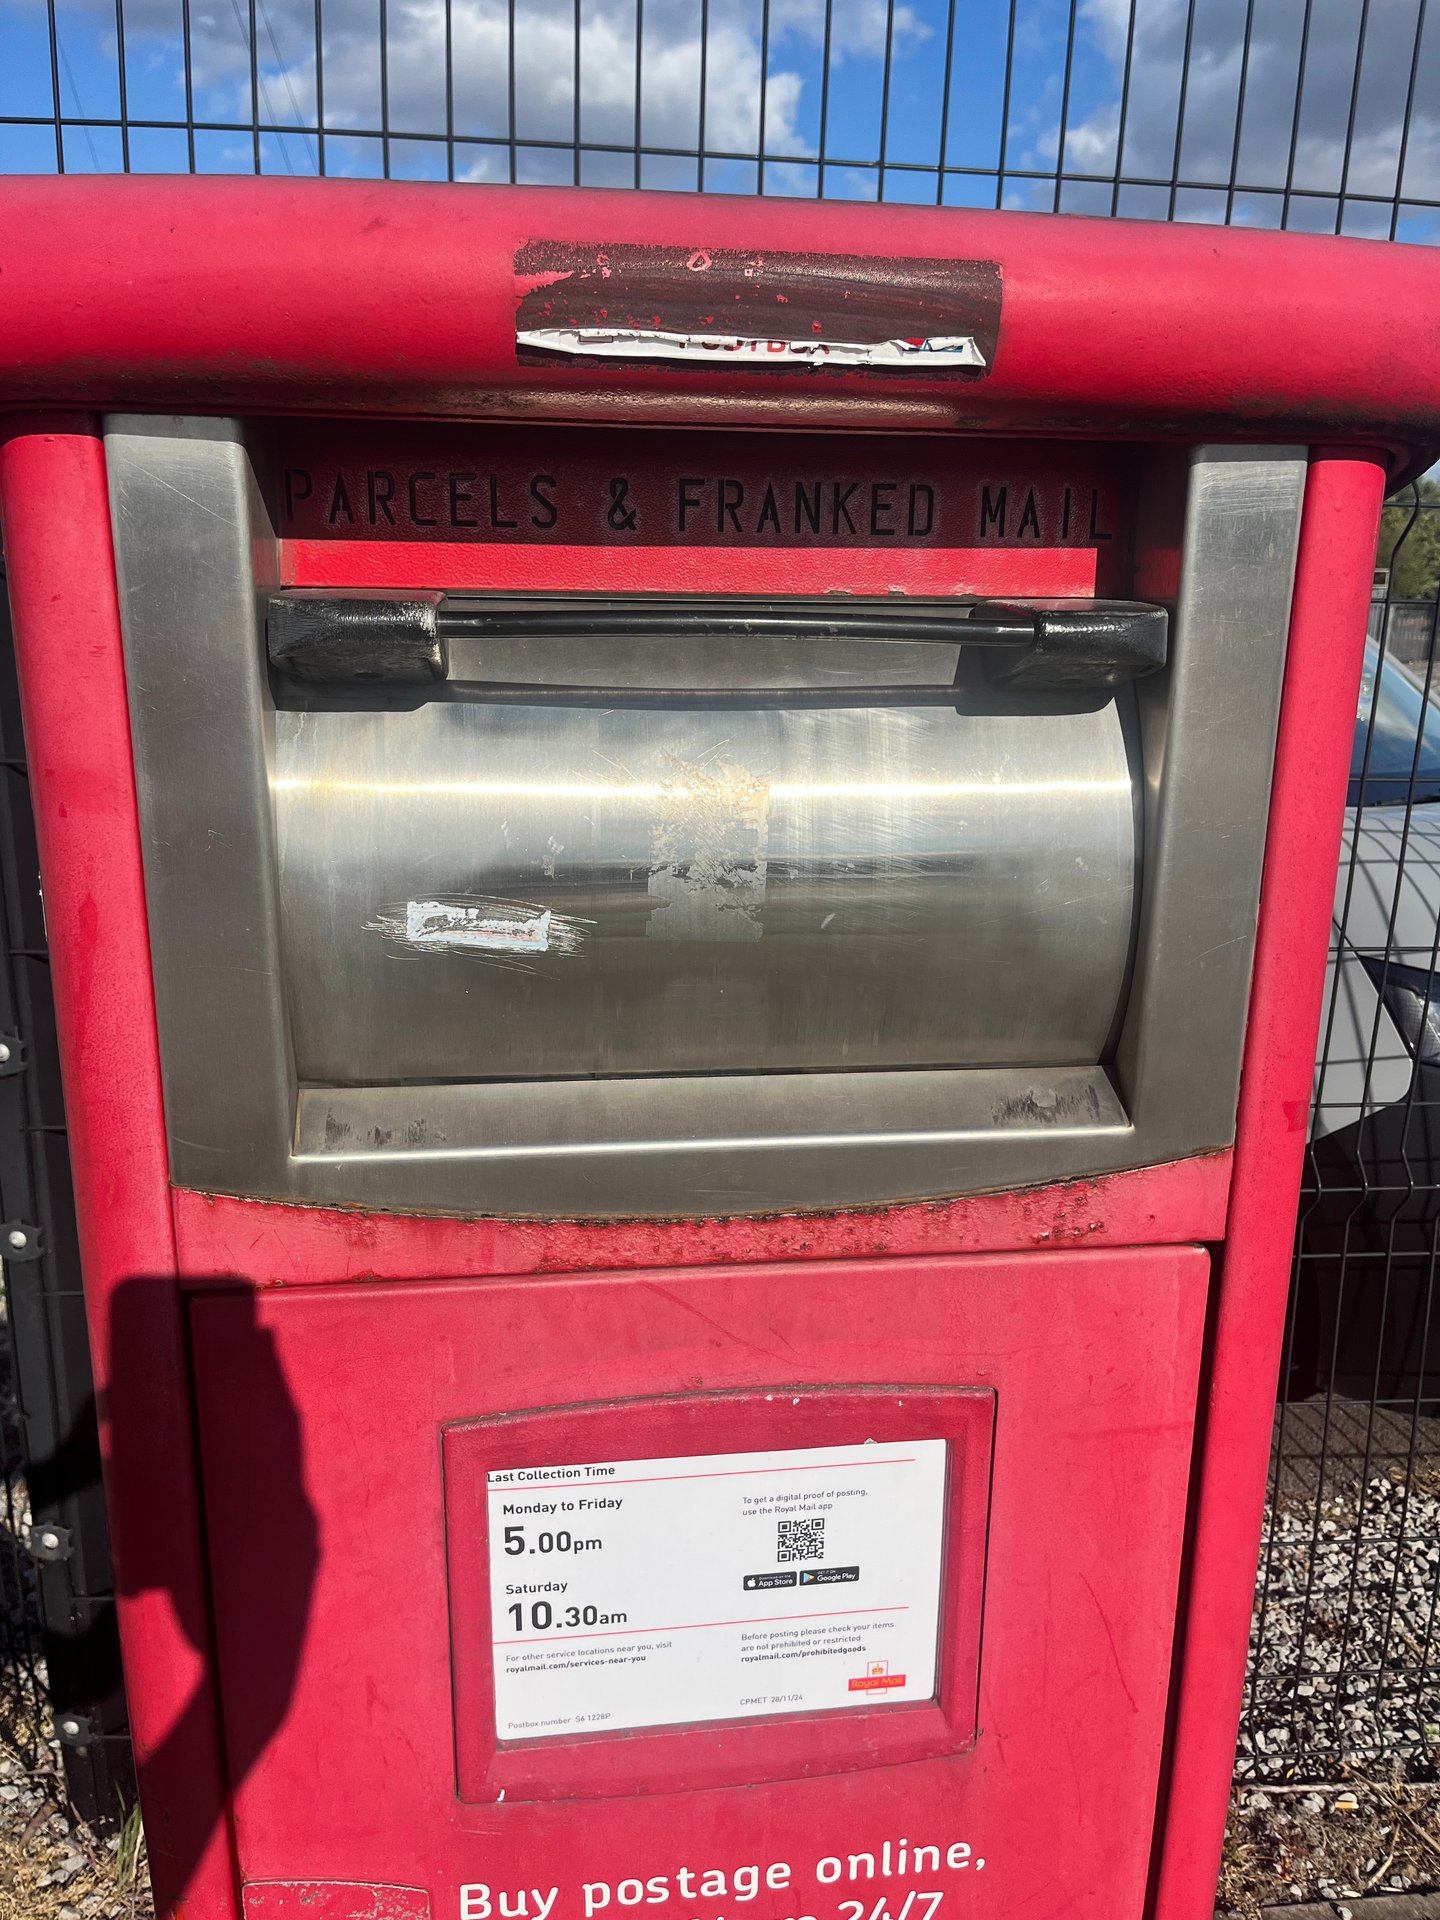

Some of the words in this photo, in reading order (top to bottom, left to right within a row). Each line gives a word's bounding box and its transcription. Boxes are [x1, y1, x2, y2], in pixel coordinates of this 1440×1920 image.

[285, 469, 558, 530] PARCELS
[608, 476, 637, 530] &
[678, 479, 933, 536] FRANKED
[980, 484, 1113, 540] MAIL
[488, 1472, 514, 1483] Last
[518, 1469, 580, 1480] Collection
[584, 1467, 615, 1477] Time
[754, 1496, 767, 1505] get
[776, 1493, 801, 1503] digital
[803, 1492, 824, 1501] proof
[827, 1490, 834, 1498] of
[503, 1502, 557, 1515] Monday
[561, 1501, 574, 1511] to
[579, 1498, 623, 1510] Friday
[775, 1504, 797, 1514] Royal
[799, 1503, 816, 1511] Mail
[818, 1503, 833, 1511] app
[504, 1526, 602, 1555] 5.00pm
[758, 1579, 773, 1587] App
[817, 1574, 841, 1582] Google
[506, 1582, 568, 1595] Saturday
[508, 1601, 627, 1631] 10.30am
[742, 1633, 767, 1641] Before
[769, 1630, 798, 1640] posting
[800, 1628, 826, 1637] please
[829, 1625, 851, 1633] check
[853, 1624, 870, 1632] your
[771, 1639, 811, 1650] prohibited
[823, 1635, 861, 1644] restricted
[506, 1654, 520, 1662] For
[522, 1652, 544, 1660] other
[546, 1650, 575, 1659] service
[578, 1646, 614, 1657] locations
[656, 1641, 672, 1649] visit
[741, 1645, 866, 1663] royalmail.com/prohibitedgoods
[506, 1655, 646, 1674] royalmail.com/services-near-you
[852, 1679, 879, 1690] Royal
[881, 1677, 903, 1685] Mail
[740, 1697, 766, 1705] CPMET
[771, 1694, 803, 1703] 28/11/24
[508, 1720, 538, 1729] Postbox
[541, 1717, 571, 1726] number
[459, 1882, 559, 1920] Buy
[582, 1863, 791, 1917] postage
[816, 1839, 986, 1885] online,
